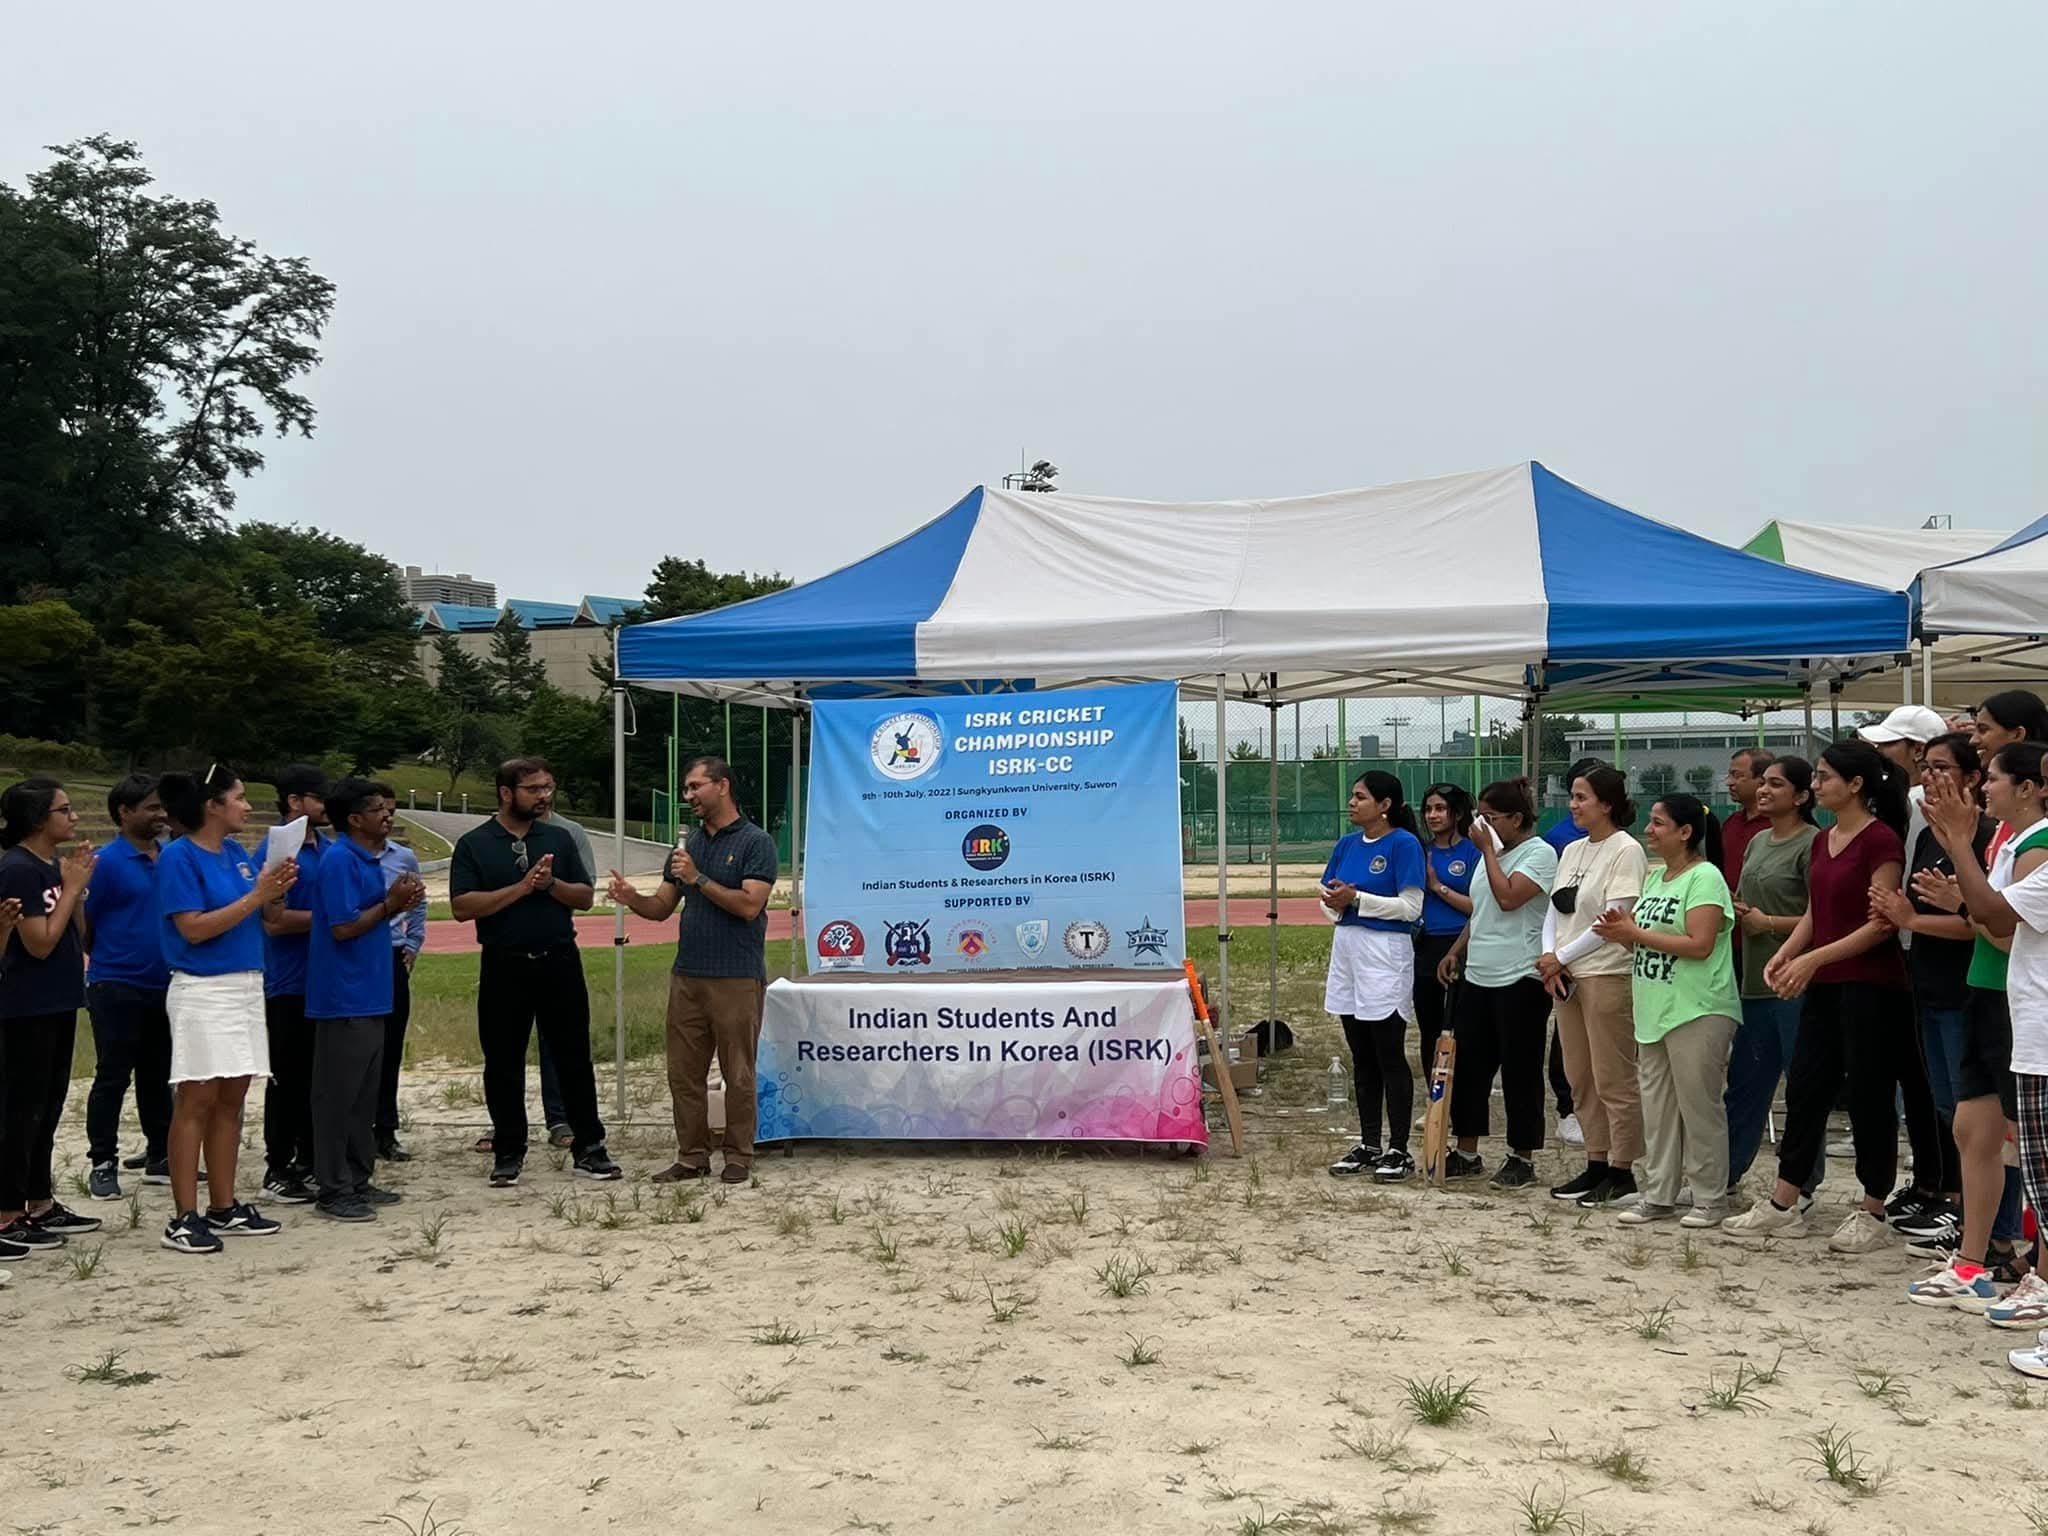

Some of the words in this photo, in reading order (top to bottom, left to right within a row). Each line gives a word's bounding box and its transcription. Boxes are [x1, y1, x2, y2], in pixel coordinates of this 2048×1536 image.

[965, 711, 1013, 728] ISRK
[1018, 706, 1106, 725] CRICKET
[954, 730, 1114, 752] CHAMPIONSHIP
[988, 756, 1073, 775] ISRK-CC
[862, 792, 877, 800] 9th
[883, 790, 903, 799] 10th
[905, 790, 926, 799] July,
[928, 788, 951, 797] 2022
[958, 784, 1030, 796] Sungkyunkwan
[1032, 782, 1082, 792] University,
[1084, 781, 1117, 790] Suwon
[945, 808, 1009, 819] ORGANIZED
[1013, 807, 1027, 817] BY
[965, 838, 1003, 853] ISRK
[862, 880, 896, 890] Indian
[899, 879, 948, 889] Students
[951, 878, 959, 887] &
[960, 875, 1029, 887] Researchers
[1031, 874, 1042, 884] in
[1044, 874, 1078, 884] Korea
[1080, 872, 1115, 883] (ISRK)
[944, 897, 1012, 908] SUPPORTED
[1015, 896, 1030, 906] BY
[1080, 931, 1094, 949] T
[1130, 934, 1164, 945] STARS
[849, 1008, 928, 1029] Indian
[937, 1007, 1055, 1029] Students
[1063, 1006, 1117, 1028] And
[798, 1040, 960, 1062] Researchers
[969, 1041, 991, 1061] In
[1001, 1041, 1080, 1062] Korea
[1089, 1039, 1172, 1066] (ISRK)
